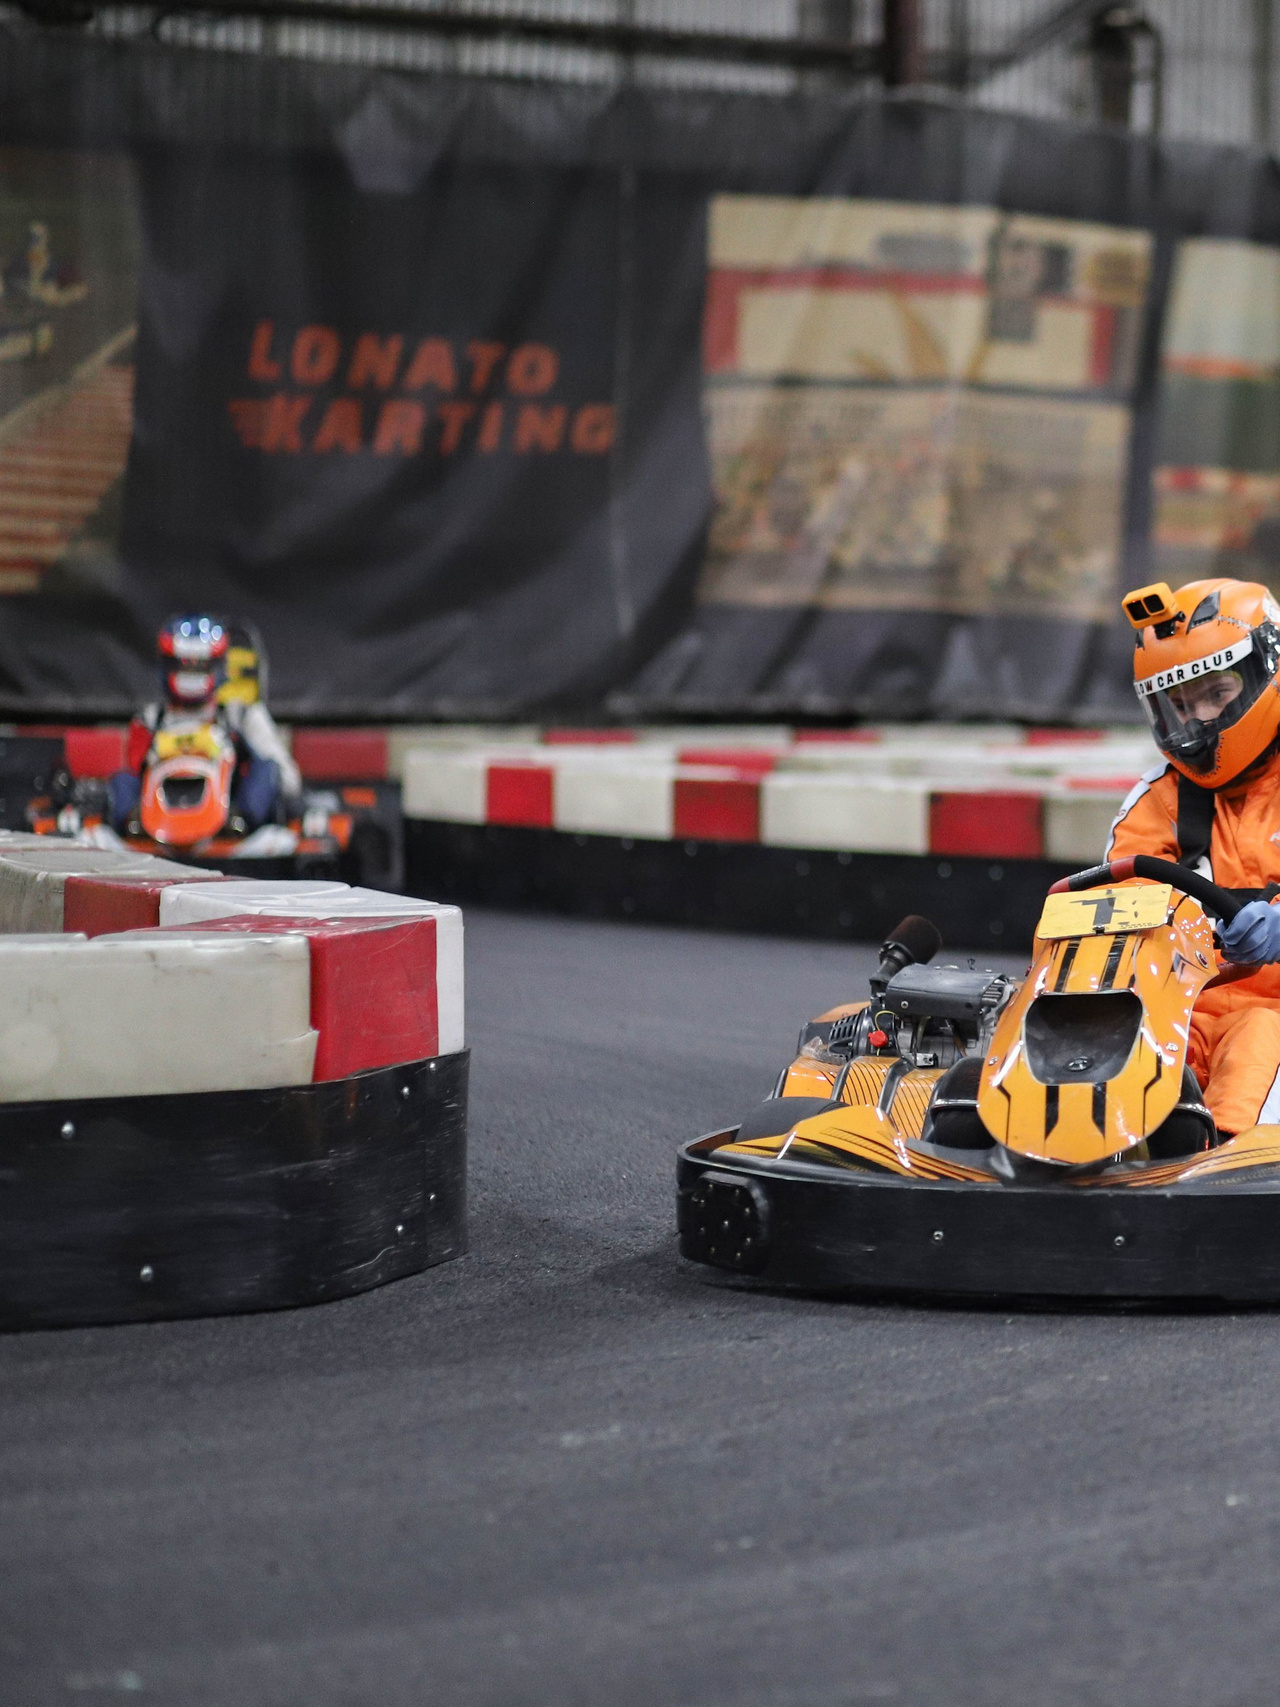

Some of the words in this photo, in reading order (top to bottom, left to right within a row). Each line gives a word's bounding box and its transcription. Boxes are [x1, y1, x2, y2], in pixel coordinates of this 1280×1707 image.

[247, 319, 561, 396] LONATO
[252, 394, 617, 458] KARTING
[1157, 669, 1185, 688] CAR
[1191, 650, 1234, 675] CLUB
